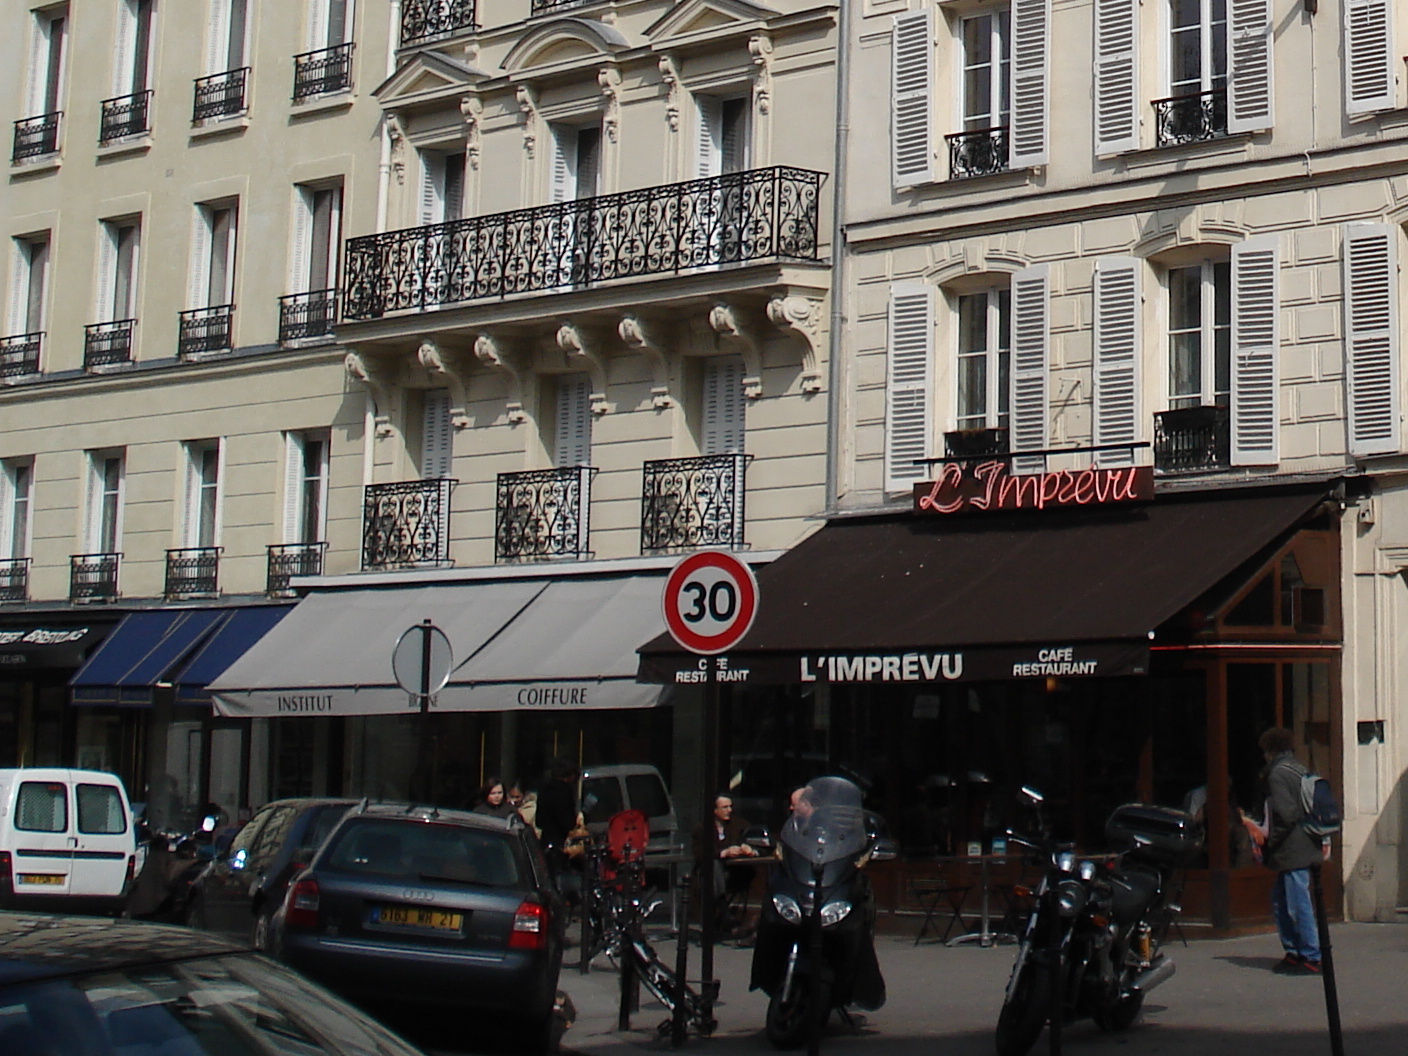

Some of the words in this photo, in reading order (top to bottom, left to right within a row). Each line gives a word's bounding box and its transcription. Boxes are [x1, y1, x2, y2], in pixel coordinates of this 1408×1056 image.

[683, 581, 737, 623] 30
[801, 652, 963, 682] L'IMPRÉVU
[1013, 661, 1098, 677] RESTAURANT
[277, 695, 333, 712] INSTITUT
[517, 687, 588, 706] COIFFURE
[440, 912, 453, 926] 21
